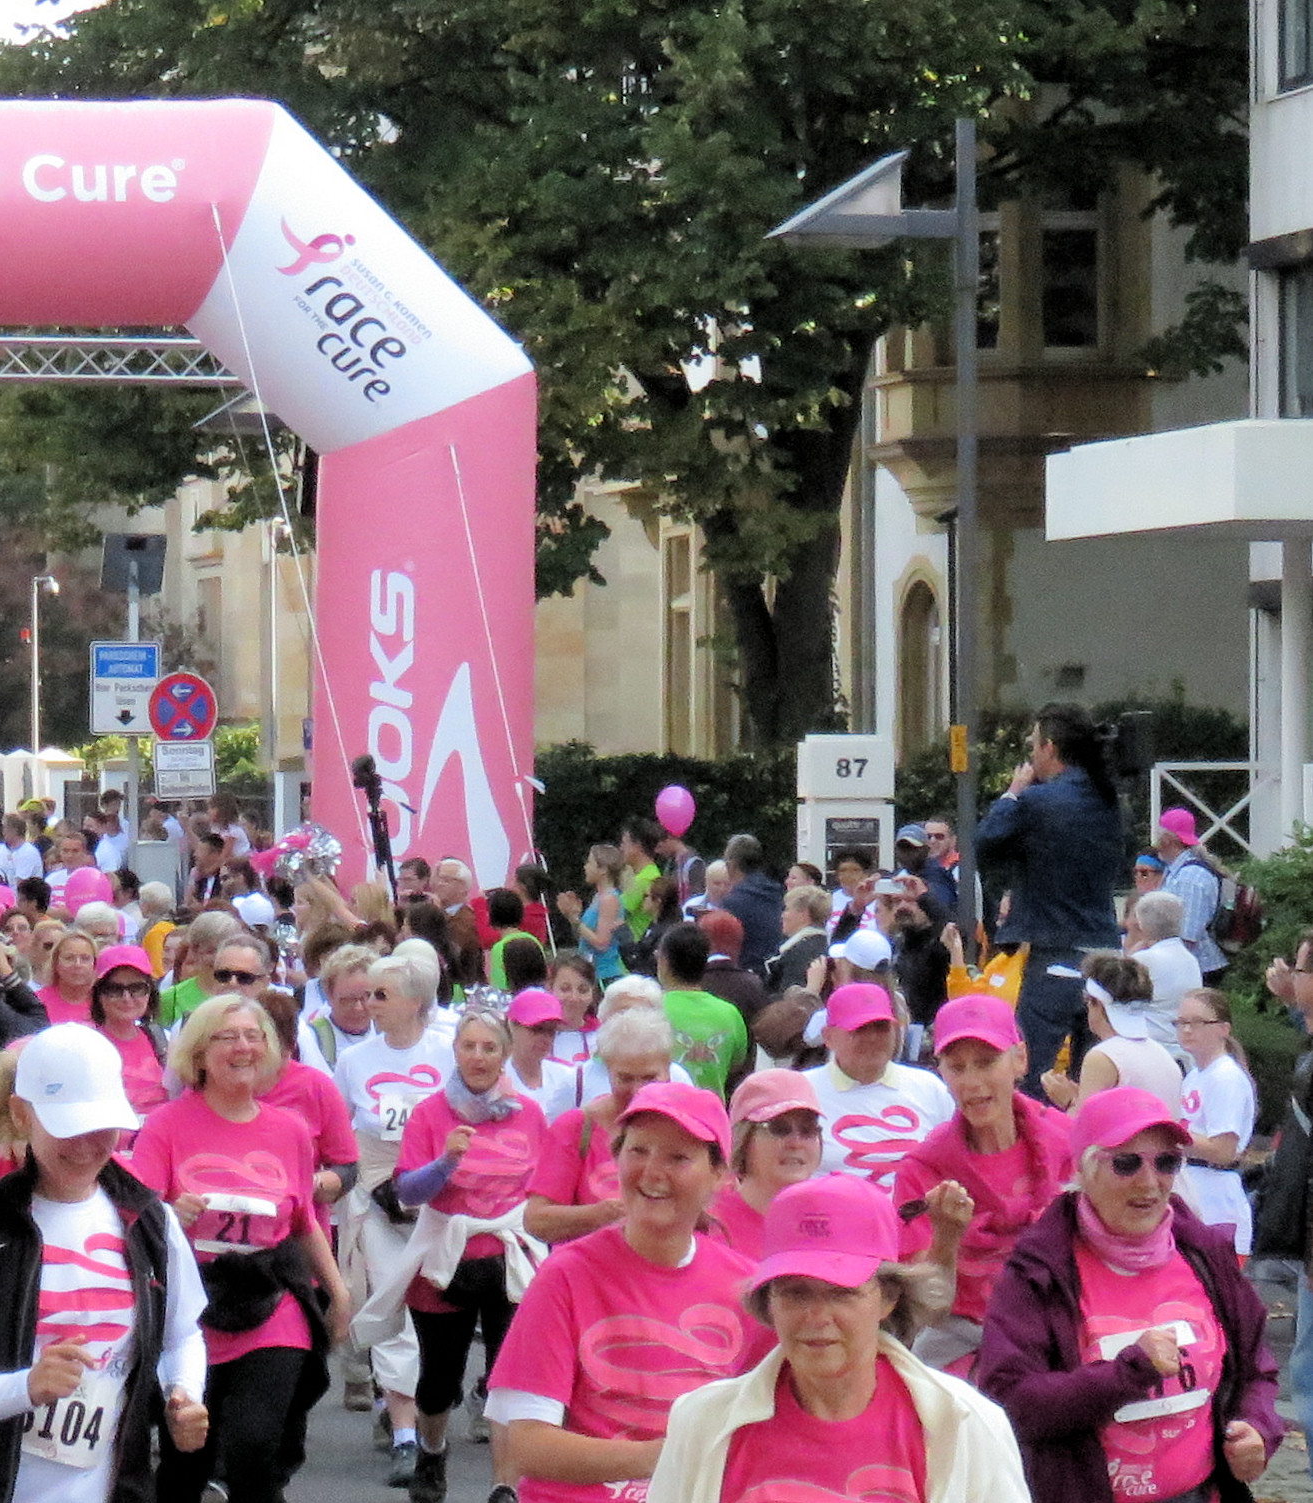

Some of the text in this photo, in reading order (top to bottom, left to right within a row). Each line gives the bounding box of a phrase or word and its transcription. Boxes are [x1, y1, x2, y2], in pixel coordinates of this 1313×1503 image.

[304, 276, 407, 369] race
[316, 332, 391, 403] cure
[836, 758, 868, 778] 87
[215, 1212, 251, 1245] 21
